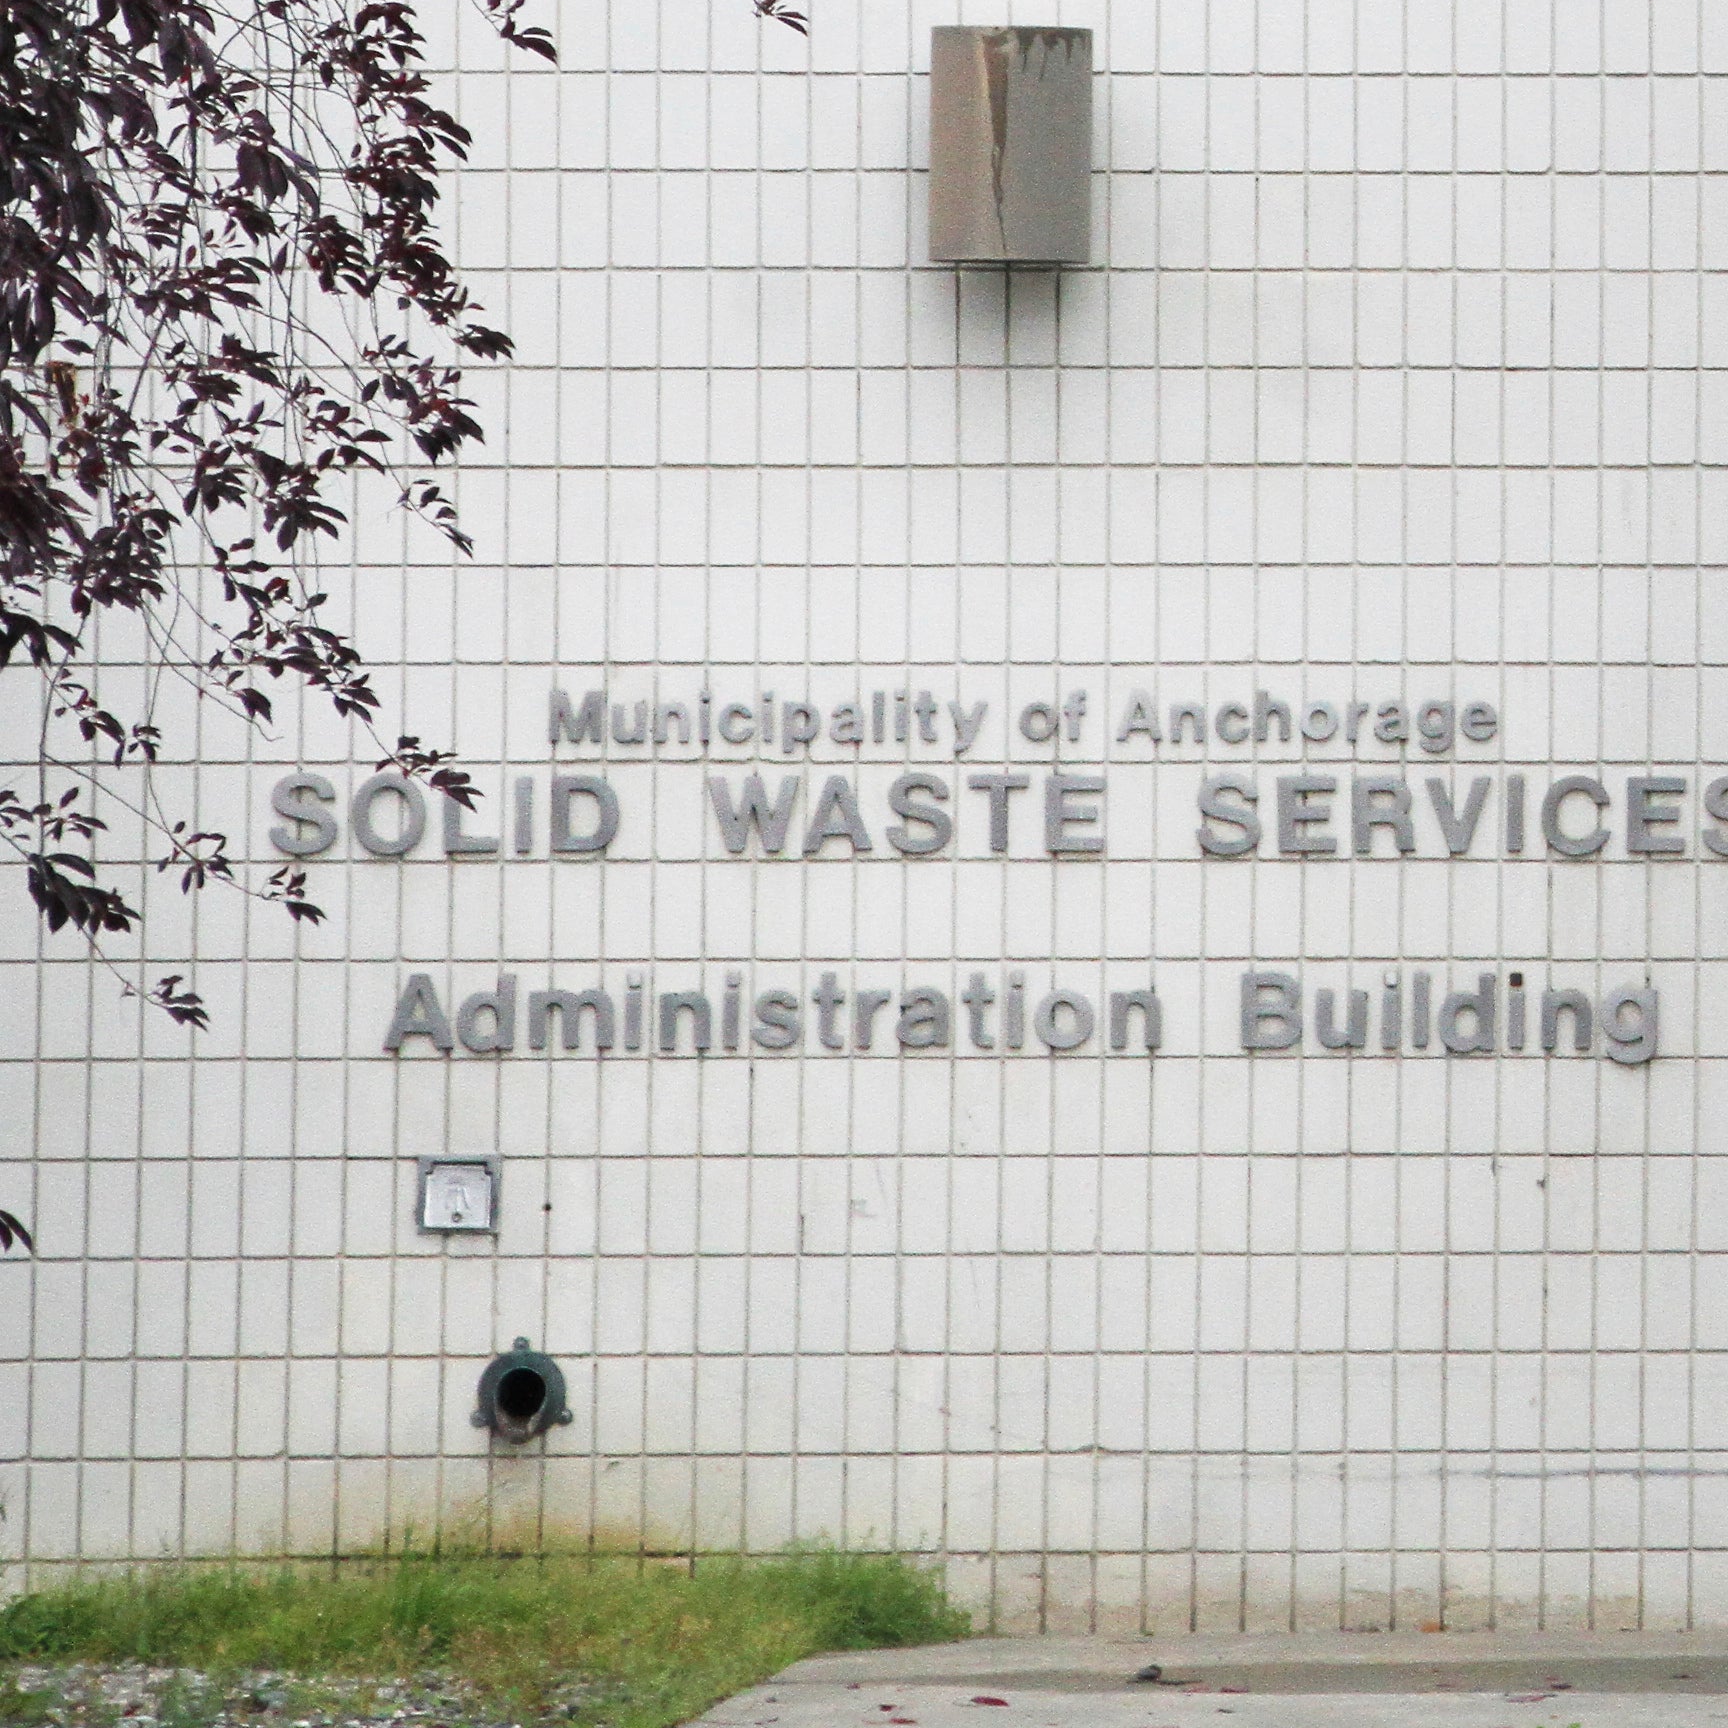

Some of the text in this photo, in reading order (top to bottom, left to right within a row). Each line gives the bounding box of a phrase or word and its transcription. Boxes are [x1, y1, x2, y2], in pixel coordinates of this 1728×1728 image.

[549, 688, 1499, 754] Municipality of Anchorage
[268, 771, 620, 857] SOLID
[708, 771, 1108, 856] WASTE
[382, 969, 1660, 1065] Administration Building
